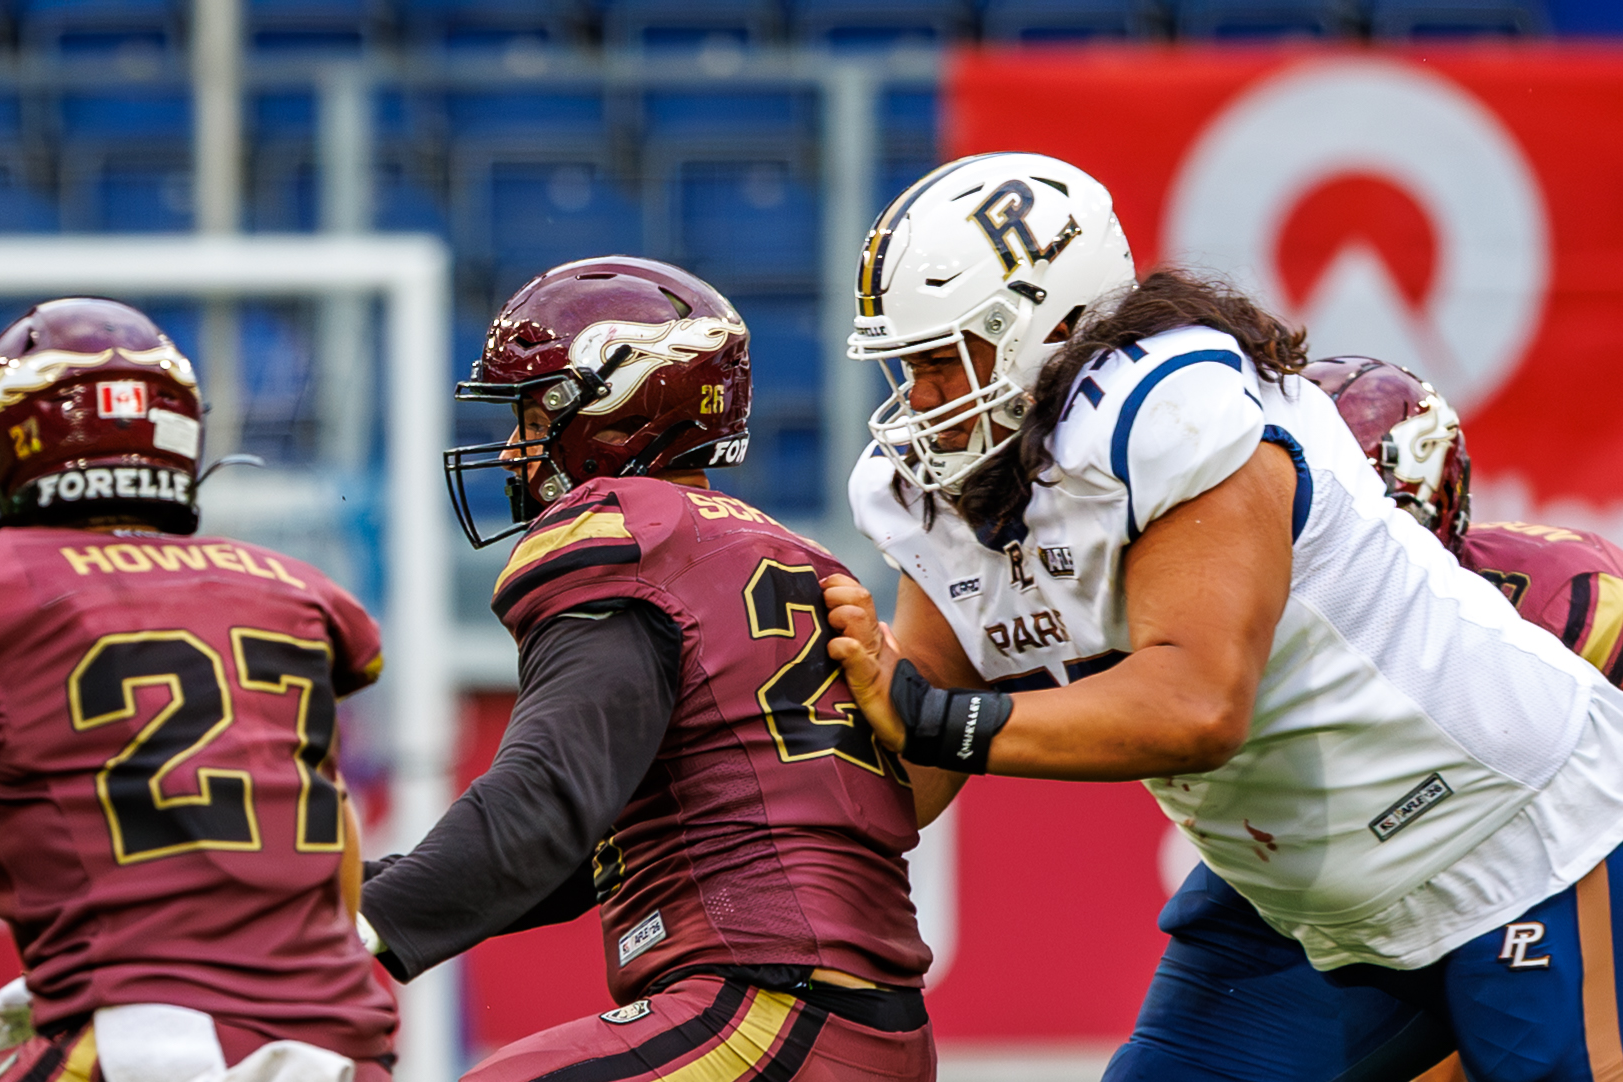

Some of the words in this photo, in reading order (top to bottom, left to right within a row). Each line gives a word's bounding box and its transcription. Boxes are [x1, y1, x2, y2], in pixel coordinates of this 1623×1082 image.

[700, 384, 725, 414] 26
[8, 416, 42, 460] 27
[37, 467, 191, 507] FORELLE
[60, 543, 307, 590] HOWELL
[67, 626, 345, 866] 27
